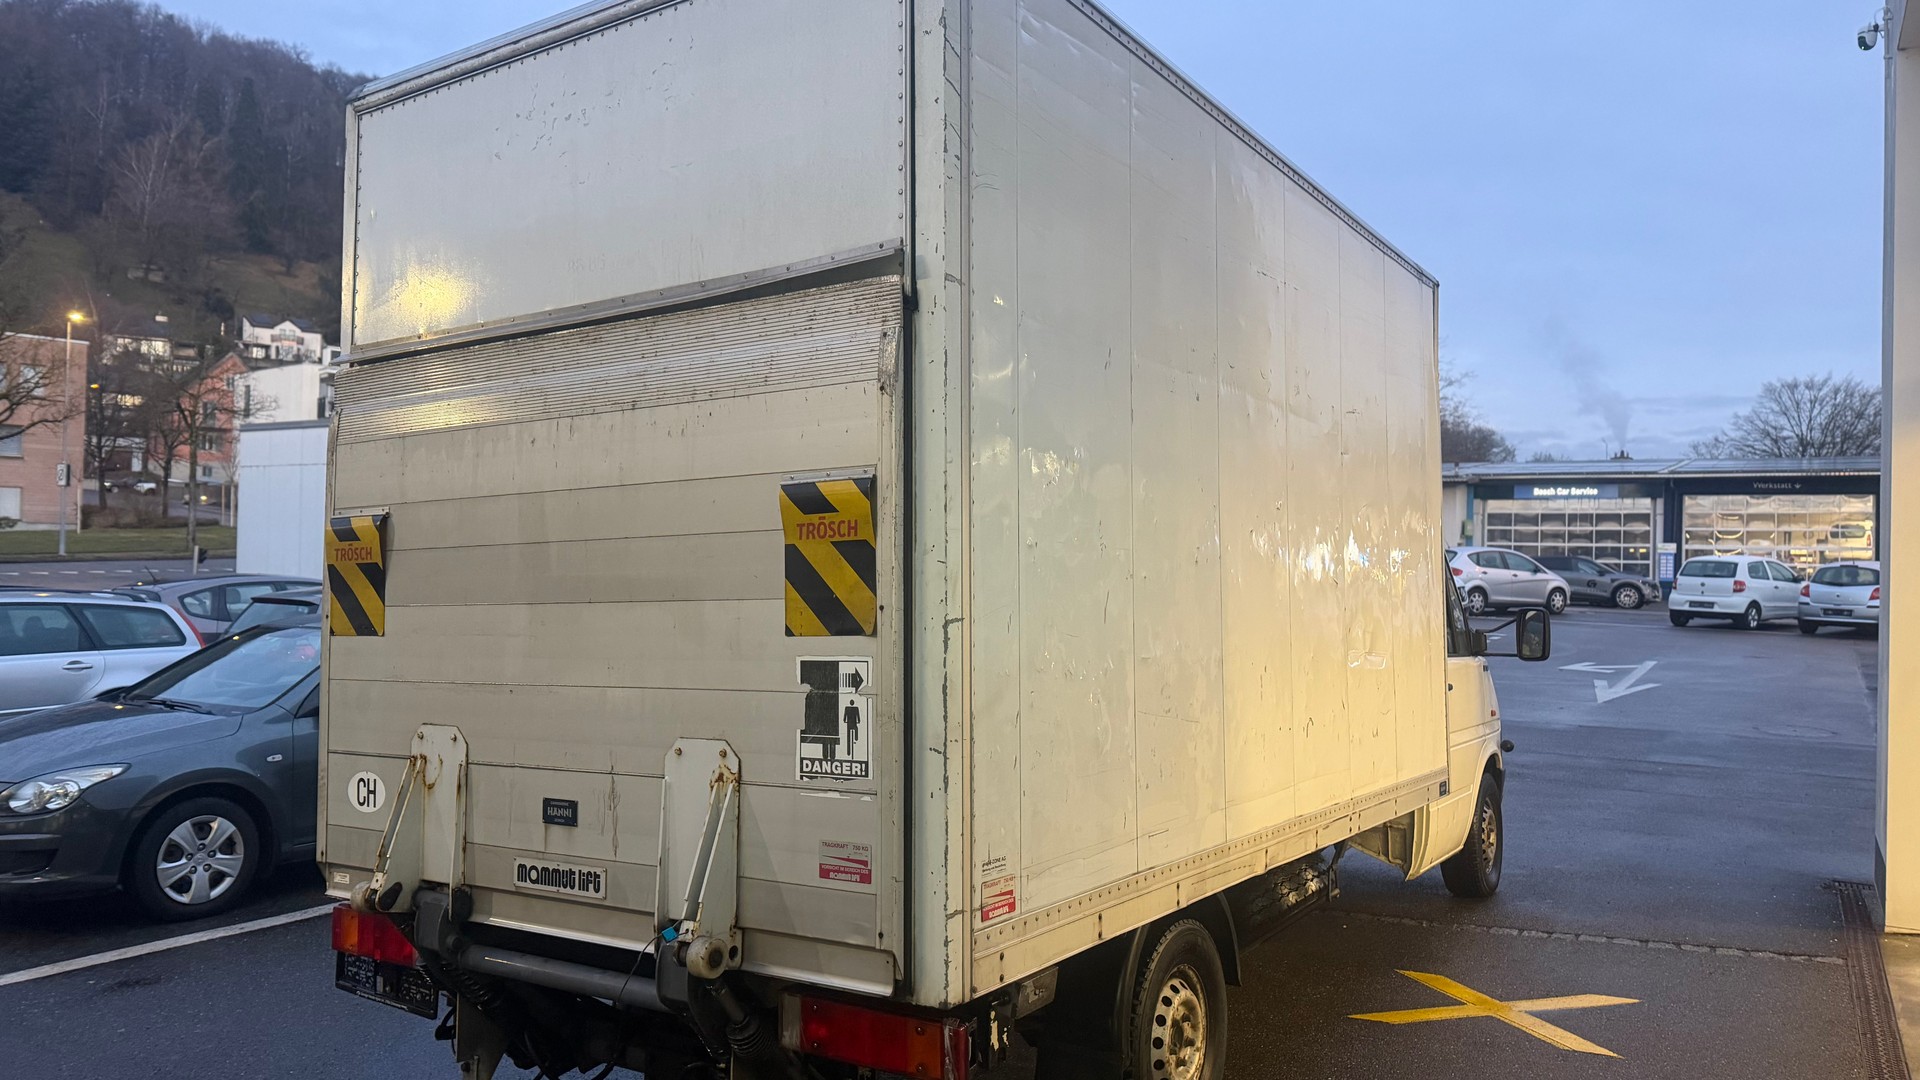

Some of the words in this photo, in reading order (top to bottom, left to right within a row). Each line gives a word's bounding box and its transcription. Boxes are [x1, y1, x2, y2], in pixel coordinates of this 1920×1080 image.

[1556, 487, 1570, 496] Car
[1570, 486, 1599, 496] Service
[802, 759, 866, 776] DANGER!
[356, 777, 377, 808] CH
[516, 863, 576, 890] mammut
[578, 869, 601, 894] lift
